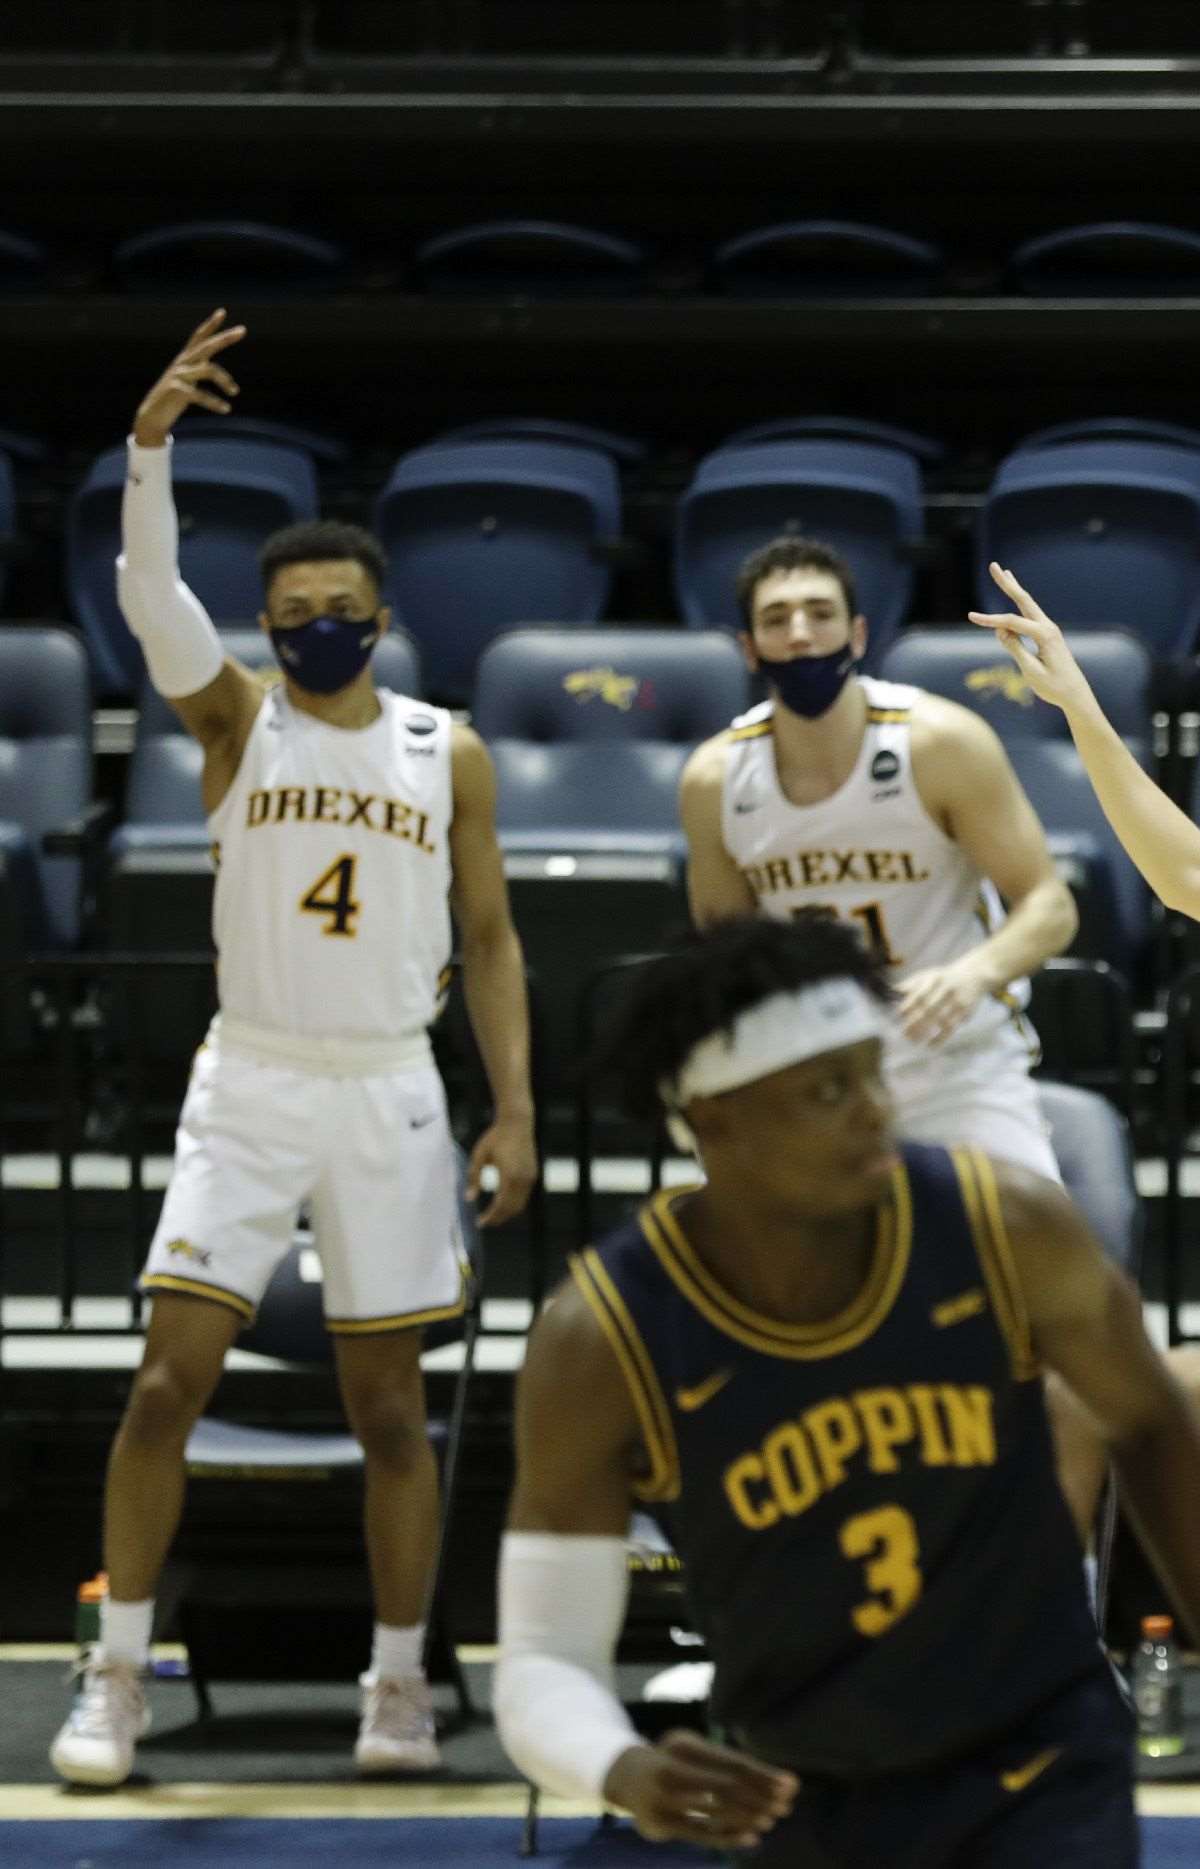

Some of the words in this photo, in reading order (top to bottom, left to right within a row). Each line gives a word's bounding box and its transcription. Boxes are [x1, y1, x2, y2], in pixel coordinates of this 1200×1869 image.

[246, 786, 437, 855] DREXEL
[298, 853, 362, 939] 4
[723, 1382, 998, 1530] COPPIN
[837, 1502, 923, 1638] 3
